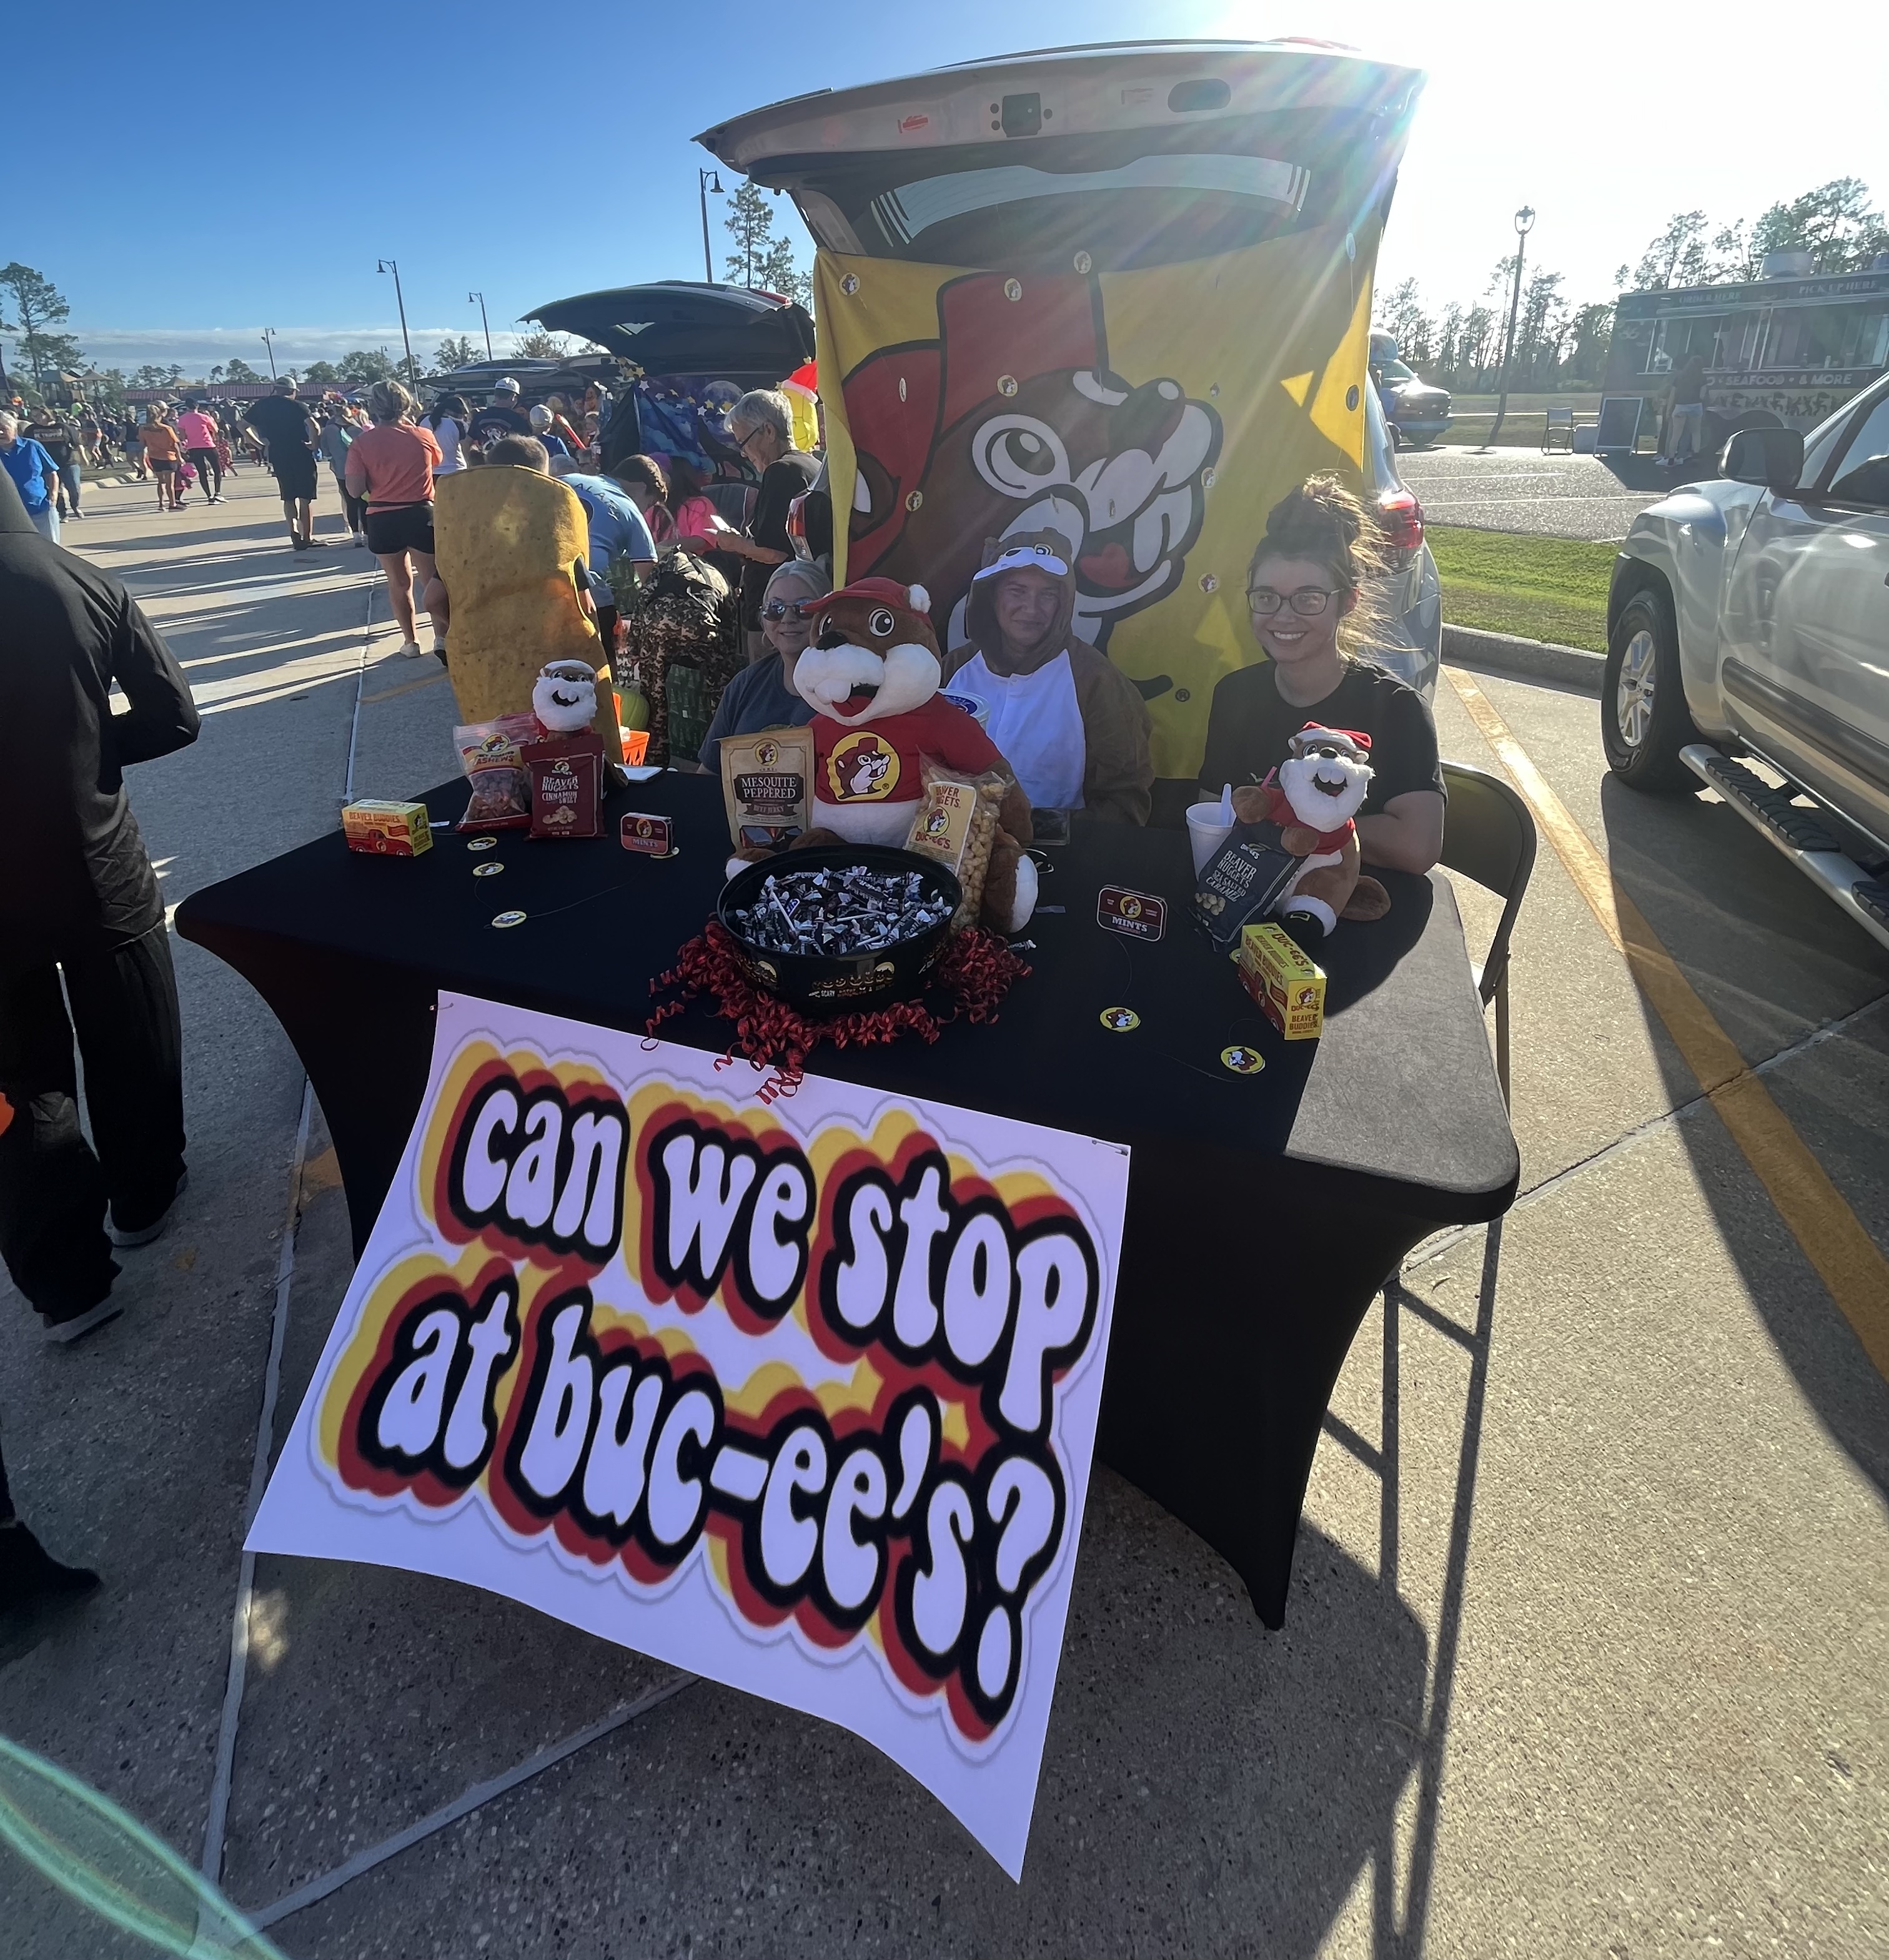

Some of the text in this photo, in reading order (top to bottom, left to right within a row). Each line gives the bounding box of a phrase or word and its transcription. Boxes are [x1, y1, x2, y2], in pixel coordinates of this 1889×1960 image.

[1725, 375, 1785, 385] SEAFOOD
[1811, 374, 1852, 384] MORE
[472, 755, 515, 766] ASHEWS
[542, 775, 578, 786] BEAVER
[741, 776, 796, 788] MESQUITE
[542, 783, 578, 792] NUGGETS
[743, 788, 796, 798] PEPPERED
[542, 791, 577, 801] CINNAMON
[632, 838, 658, 848] MINTS
[1222, 850, 1257, 880] BEAVER
[1217, 859, 1251, 888] NUGGETS
[1212, 870, 1246, 897] SEA SALTED
[1206, 877, 1241, 902] CARAMEL
[1112, 916, 1148, 932] MINTS
[1292, 1014, 1318, 1022] BEAVER
[1289, 1021, 1318, 1031] BUDDIES
[452, 1081, 1094, 1440] can we stop
[366, 1280, 1061, 1705] at buc-ee's?
